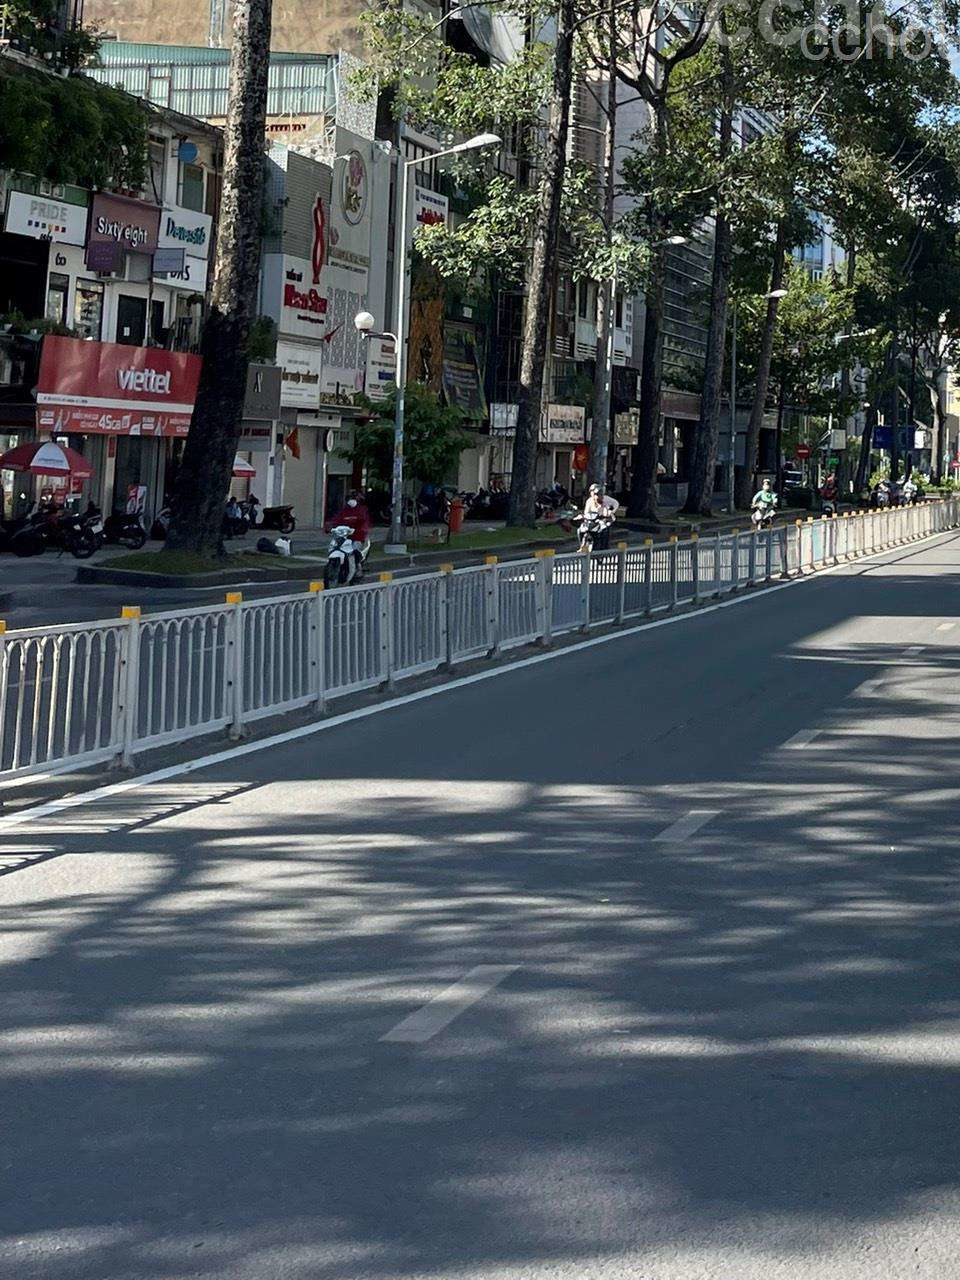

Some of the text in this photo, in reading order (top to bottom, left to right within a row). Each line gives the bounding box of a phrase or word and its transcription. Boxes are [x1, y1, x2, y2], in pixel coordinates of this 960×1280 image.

[29, 200, 68, 222] PRIDE
[98, 217, 122, 242] Sixty
[124, 225, 148, 247] eight
[117, 366, 172, 394] viettel
